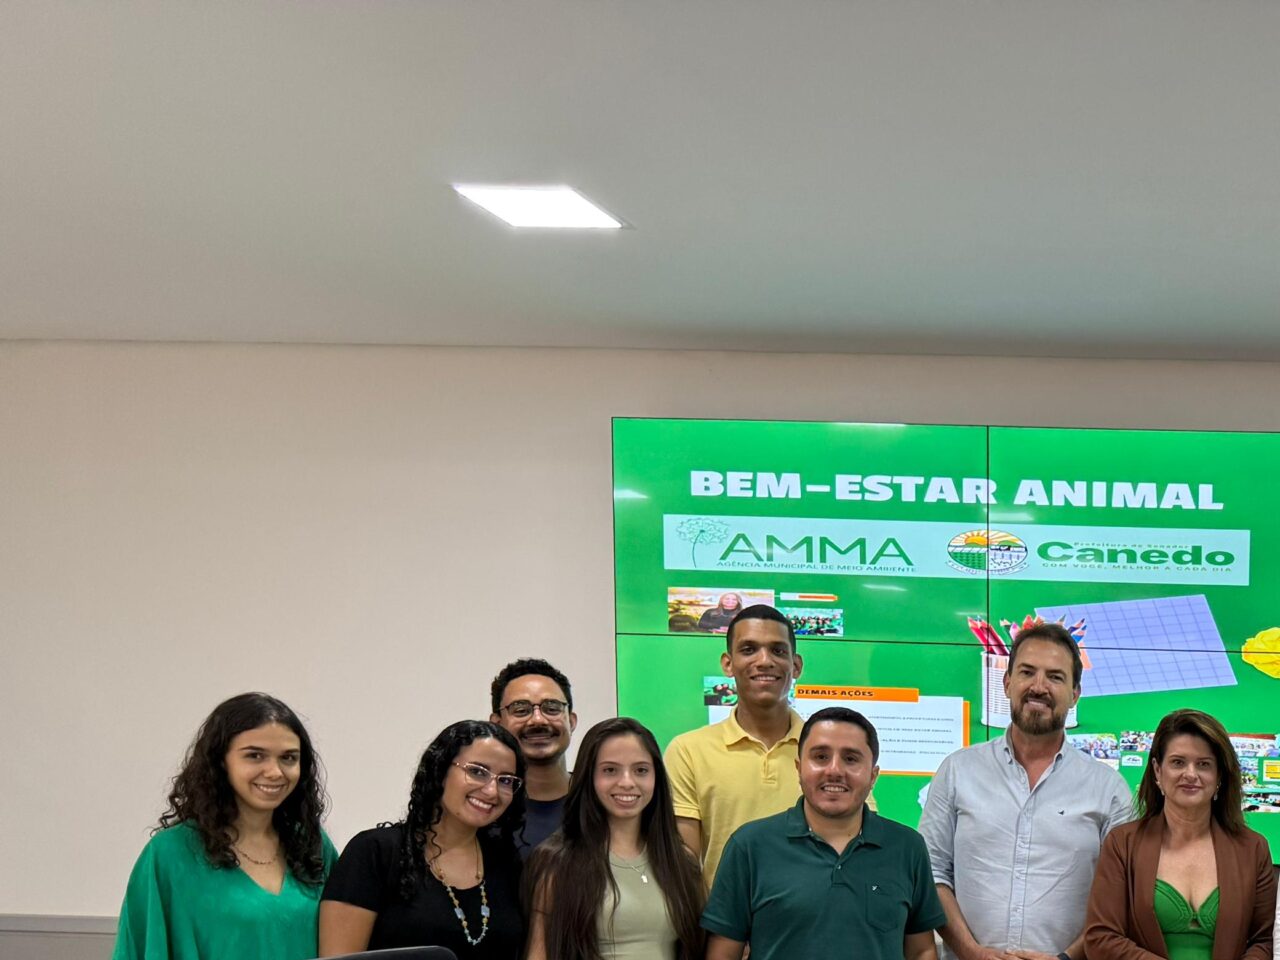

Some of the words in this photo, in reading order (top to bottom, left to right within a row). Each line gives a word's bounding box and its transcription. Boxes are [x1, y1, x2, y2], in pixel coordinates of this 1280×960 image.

[690, 470, 998, 505] BEM-ESTAR
[1013, 479, 1225, 510] ANIMAL
[718, 533, 914, 566] AMMA
[1037, 541, 1236, 567] Canedo
[717, 559, 761, 568] AGÊNCIA
[762, 562, 818, 570] MUNICIPAL
[865, 565, 916, 573] AMBIENTE
[797, 688, 838, 696] DEMAIS
[840, 688, 874, 698] AÇÕES
